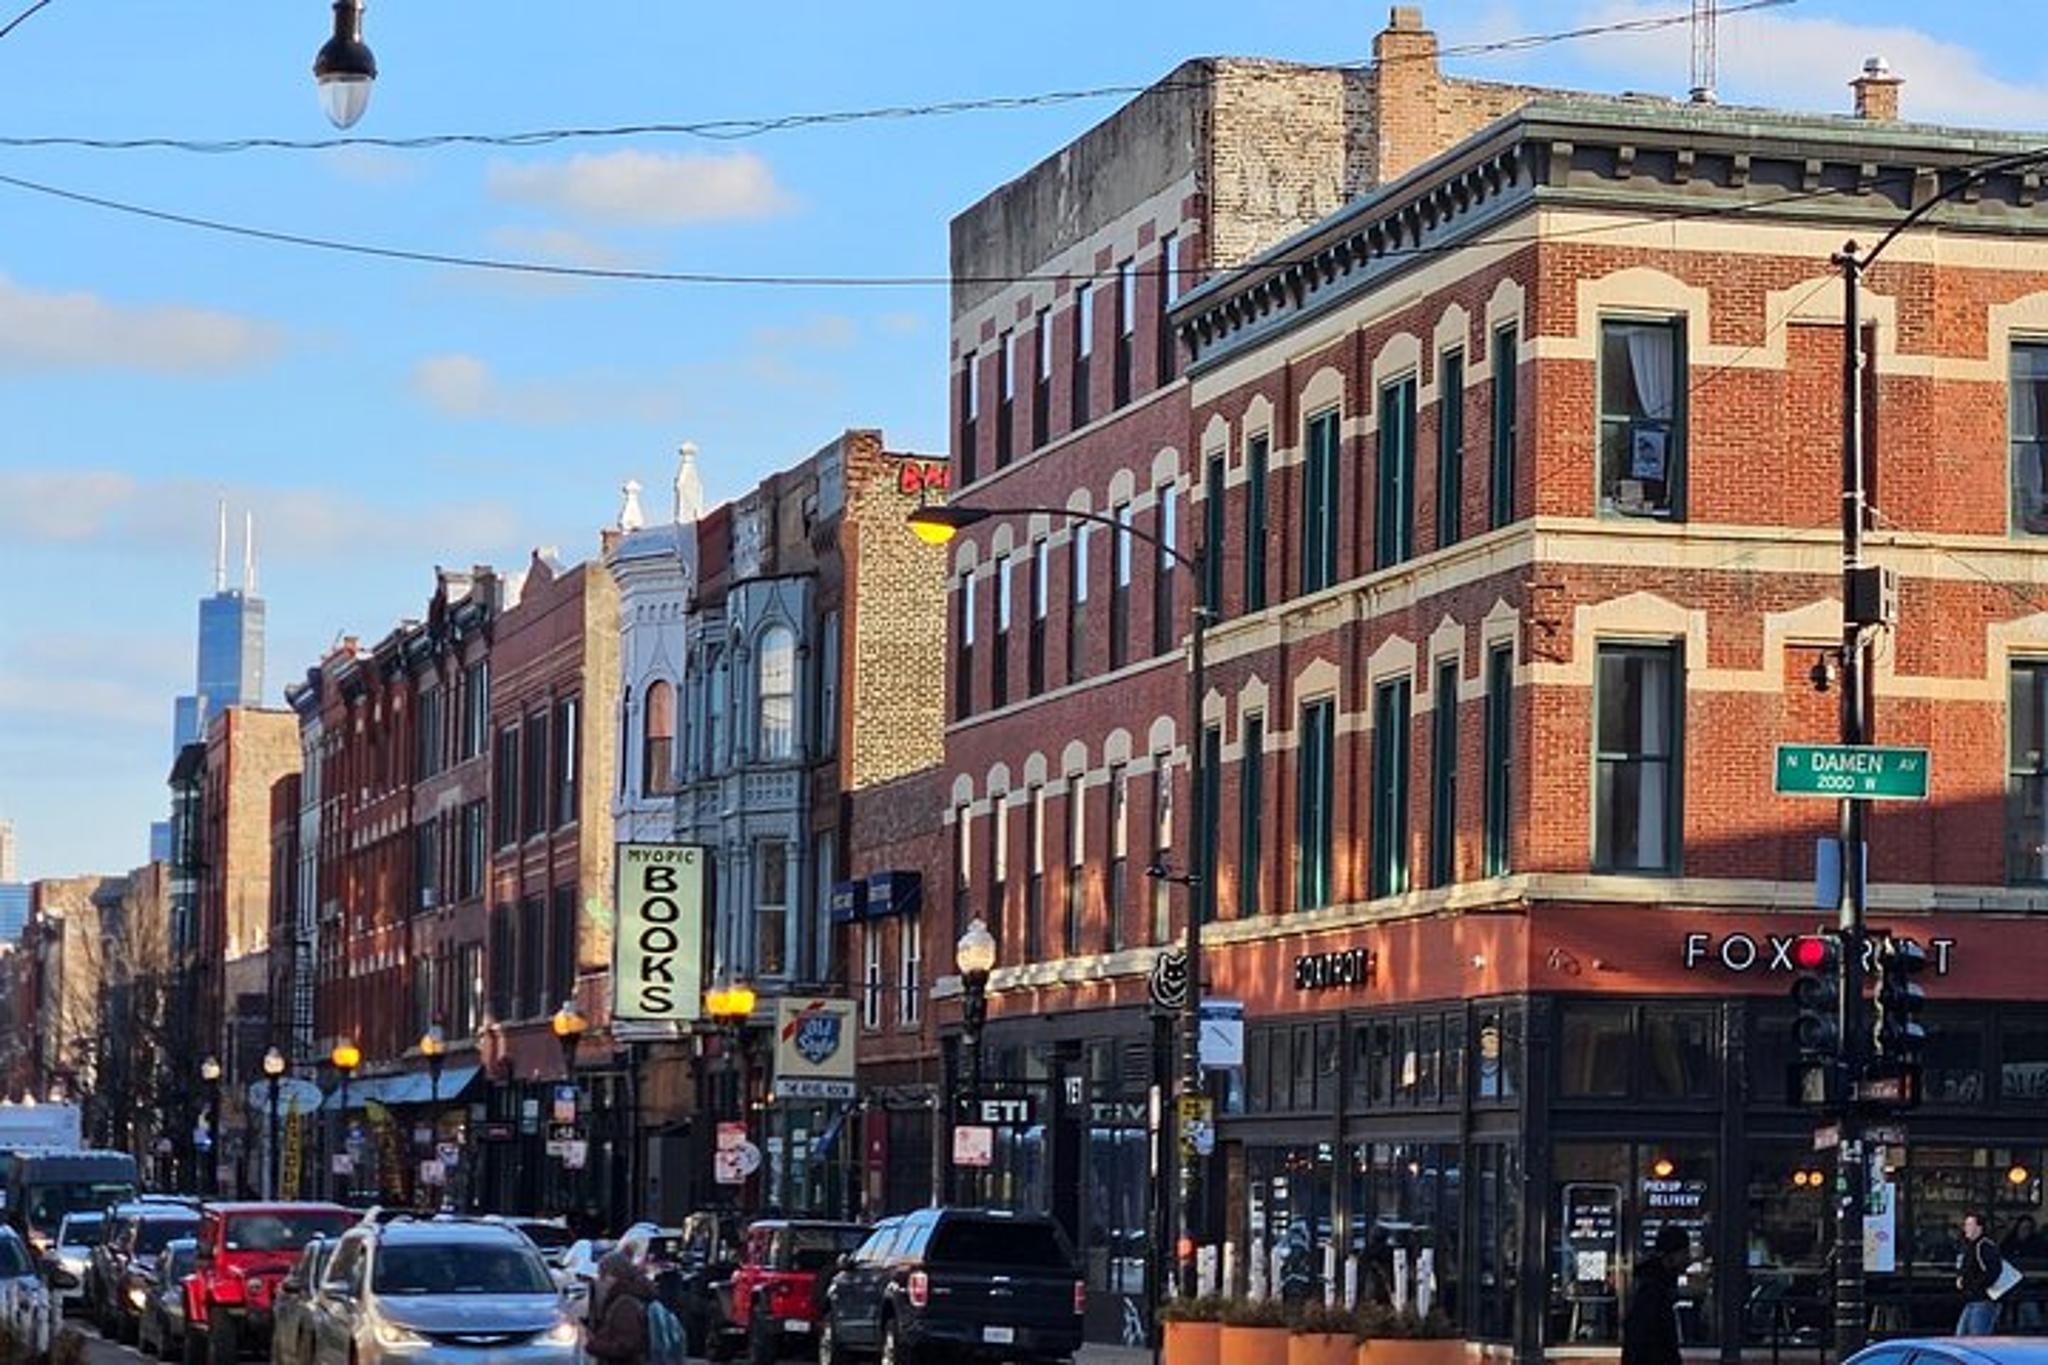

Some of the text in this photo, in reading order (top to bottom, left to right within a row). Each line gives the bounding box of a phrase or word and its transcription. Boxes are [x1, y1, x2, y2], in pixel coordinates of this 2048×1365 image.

[1786, 755, 1798, 768] N
[1811, 752, 1883, 773] DAMEN
[1817, 774, 1876, 790] 2000 W
[628, 850, 695, 864] MYOPIC
[639, 866, 680, 1013] BOOKS
[960, 1100, 1028, 1122] ETI
[1649, 1195, 1700, 1207] DELIVERY
